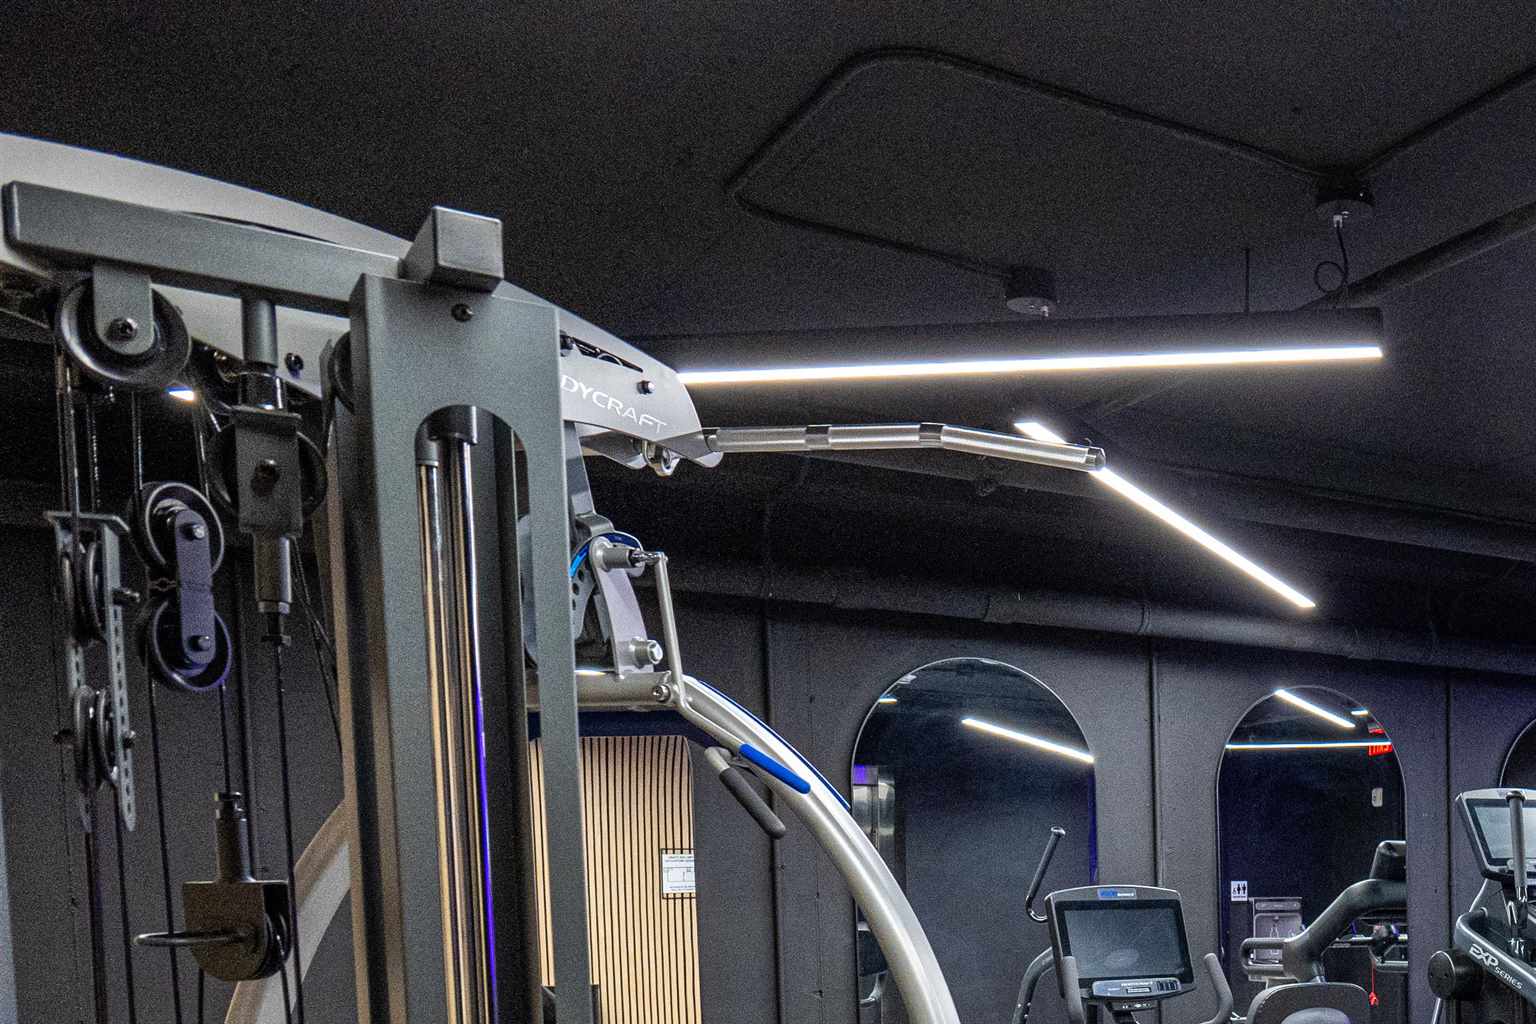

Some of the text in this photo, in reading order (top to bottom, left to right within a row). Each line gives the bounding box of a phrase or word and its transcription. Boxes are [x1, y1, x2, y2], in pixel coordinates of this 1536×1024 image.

[560, 374, 668, 434] DYCRAFT
[1469, 943, 1523, 990] EXP SERIES
